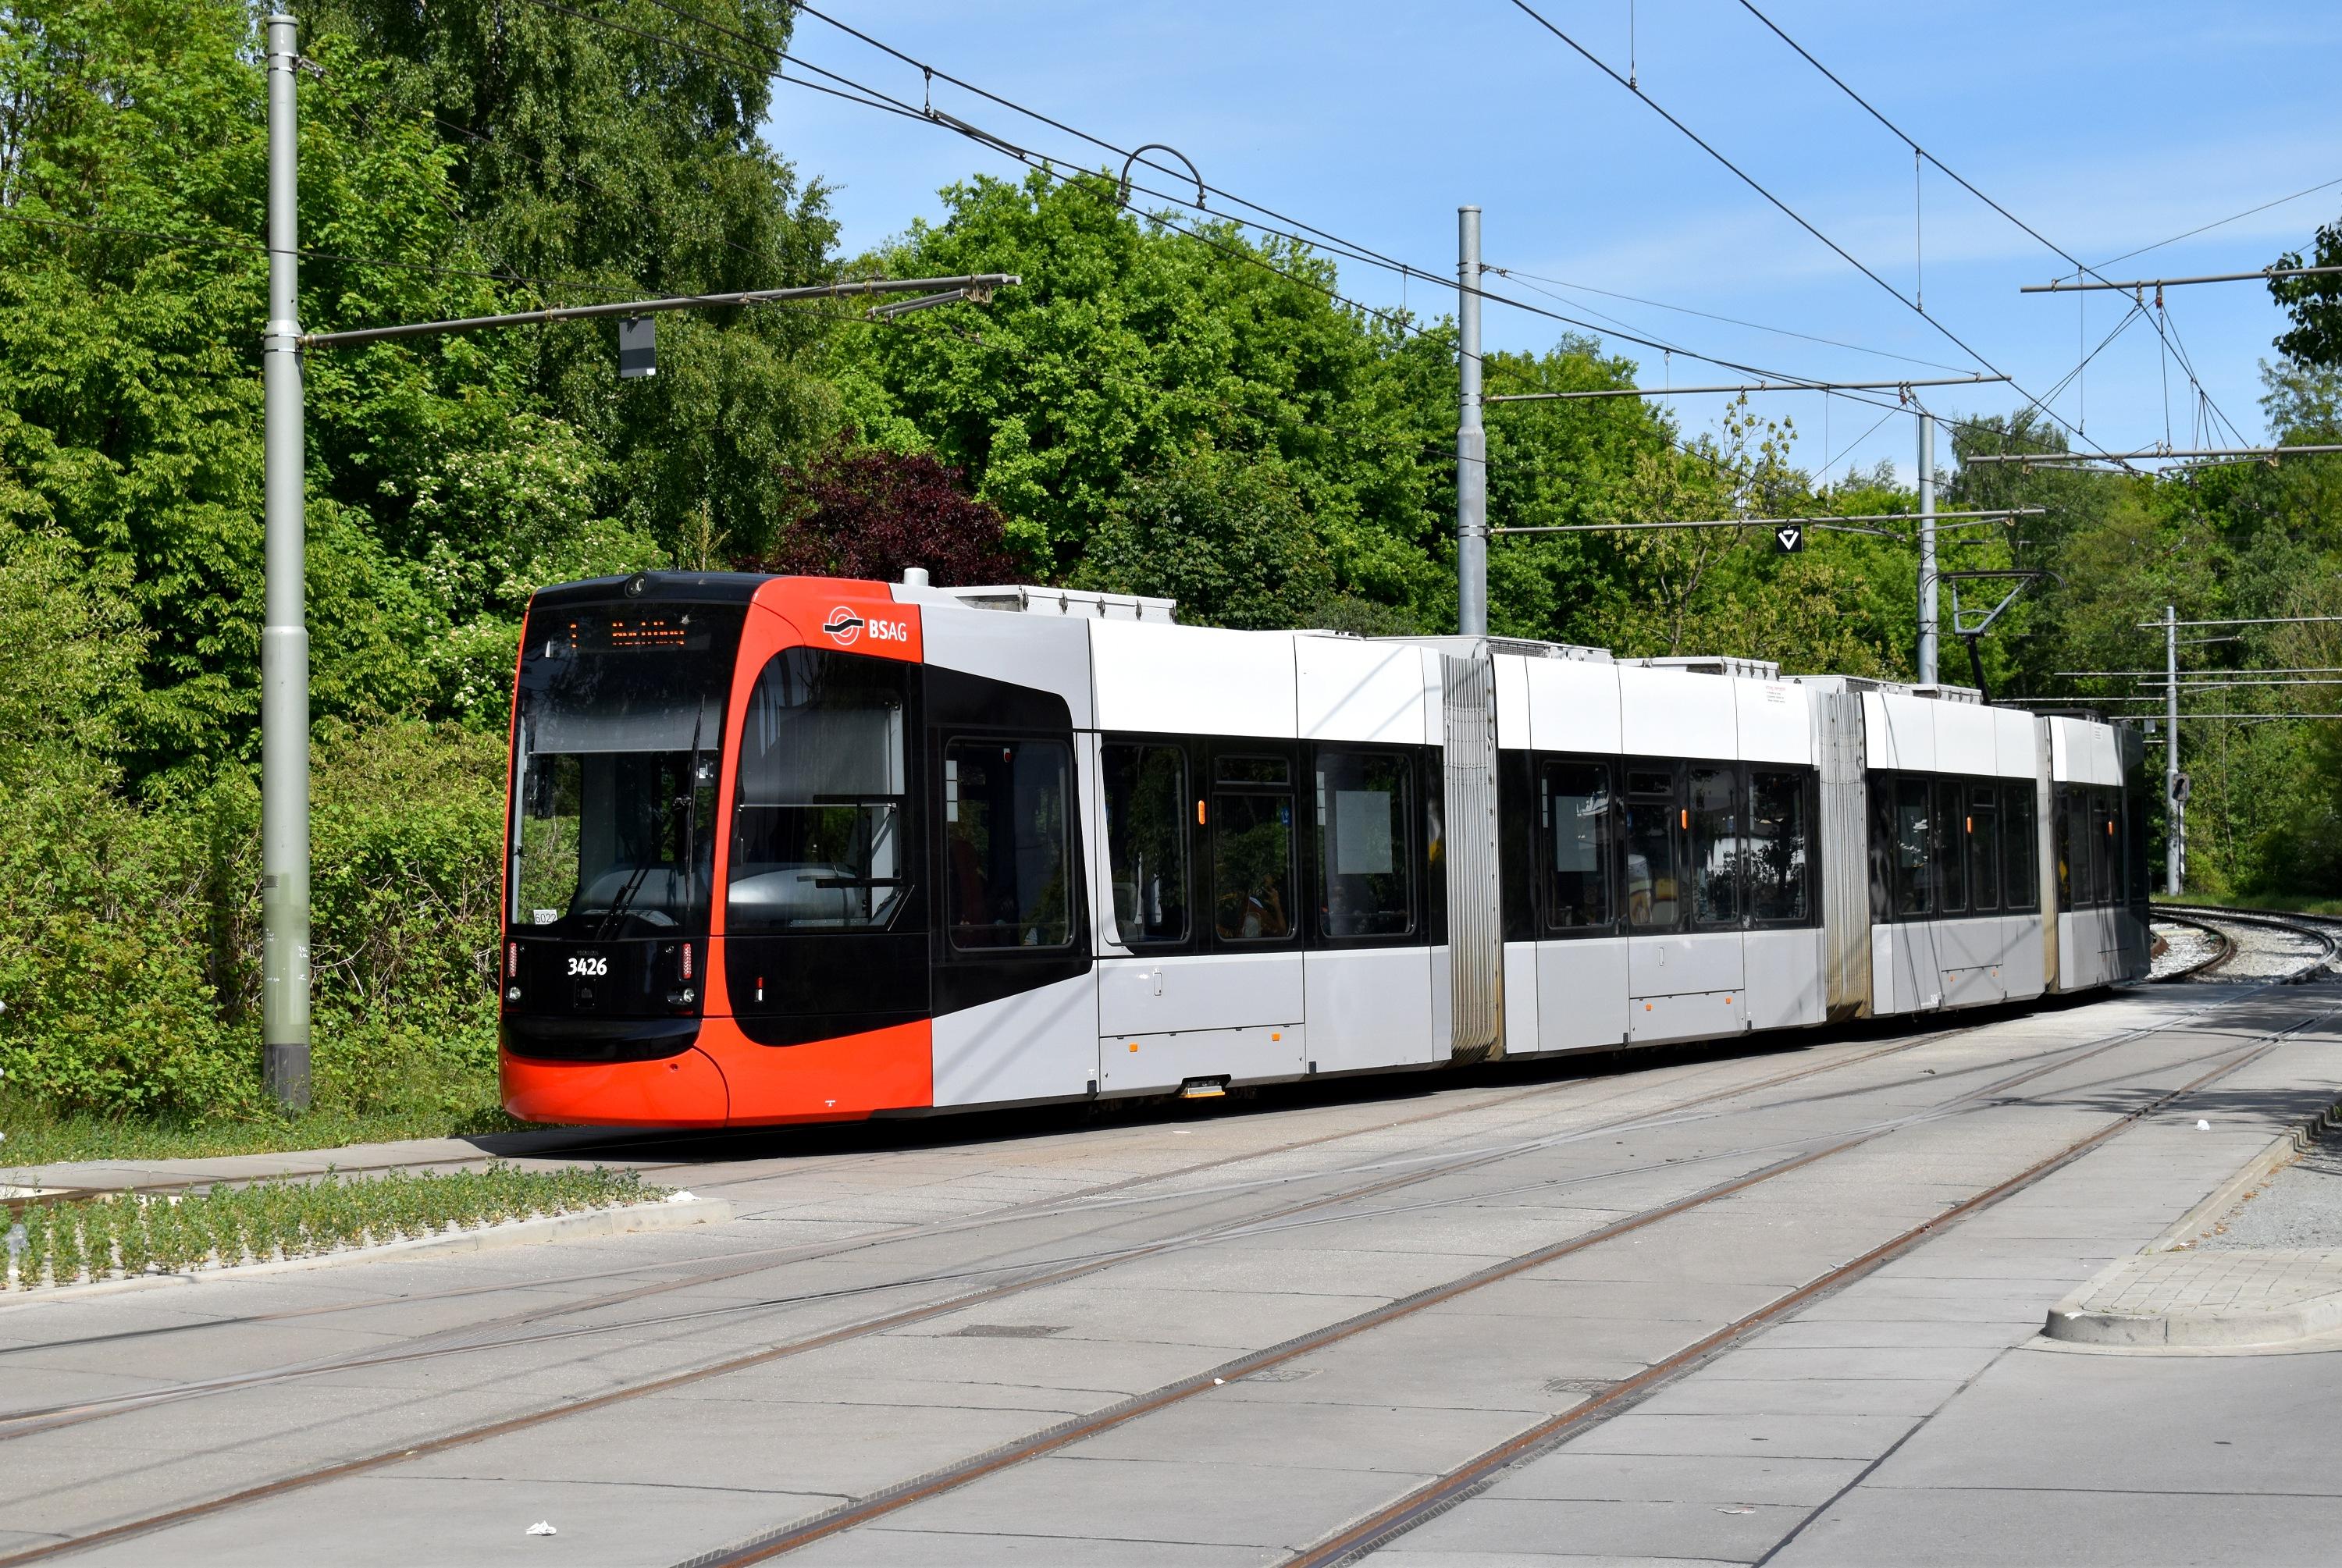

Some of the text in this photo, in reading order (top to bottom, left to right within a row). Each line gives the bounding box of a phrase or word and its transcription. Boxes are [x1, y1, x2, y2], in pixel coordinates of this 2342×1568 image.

[869, 619, 907, 642] BSAG
[535, 913, 557, 924] 6022
[568, 957, 607, 976] 3426
